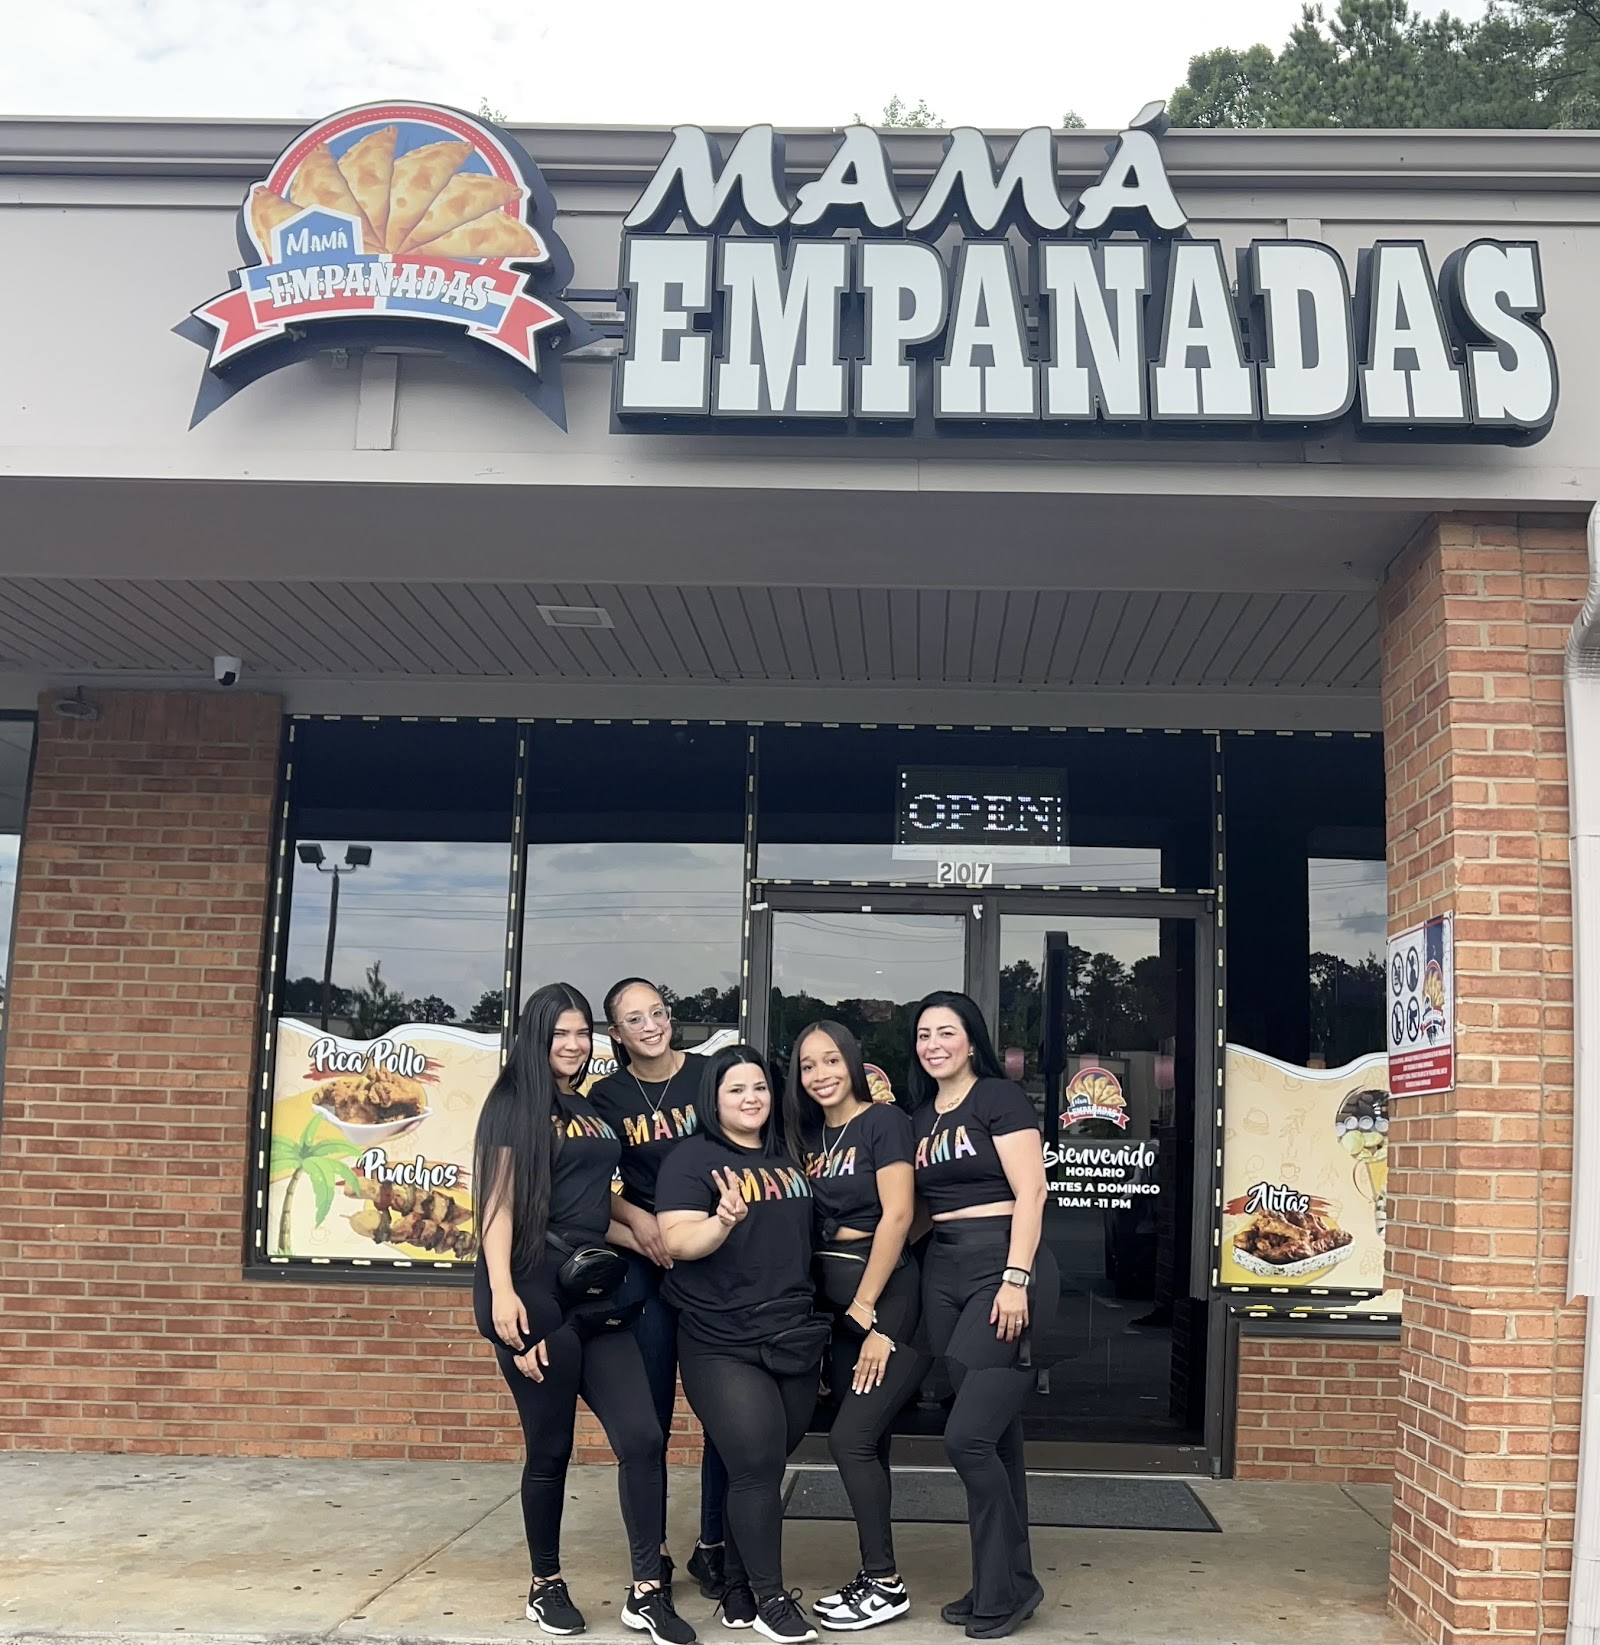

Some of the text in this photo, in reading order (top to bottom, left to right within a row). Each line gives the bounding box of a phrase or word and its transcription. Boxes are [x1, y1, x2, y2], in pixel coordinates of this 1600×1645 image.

[622, 100, 1189, 231] MAMÁ
[266, 262, 497, 311] EMPANADAS
[618, 232, 1556, 428] EMPANADAS
[909, 794, 1054, 832] OPEN
[940, 863, 990, 883] 207
[308, 1037, 427, 1077] Pica Pollo
[623, 1104, 697, 1147] MAM
[915, 1125, 977, 1170] AMA
[356, 1147, 460, 1192] Pinchos
[732, 1166, 813, 1203] MAM
[1045, 1181, 1161, 1195] RTES A DOMINGO
[1065, 1166, 1126, 1178] HORARIO
[1057, 1197, 1092, 1208] 10AM
[1111, 1199, 1132, 1209] PM
[1245, 1182, 1310, 1213] Alitas
